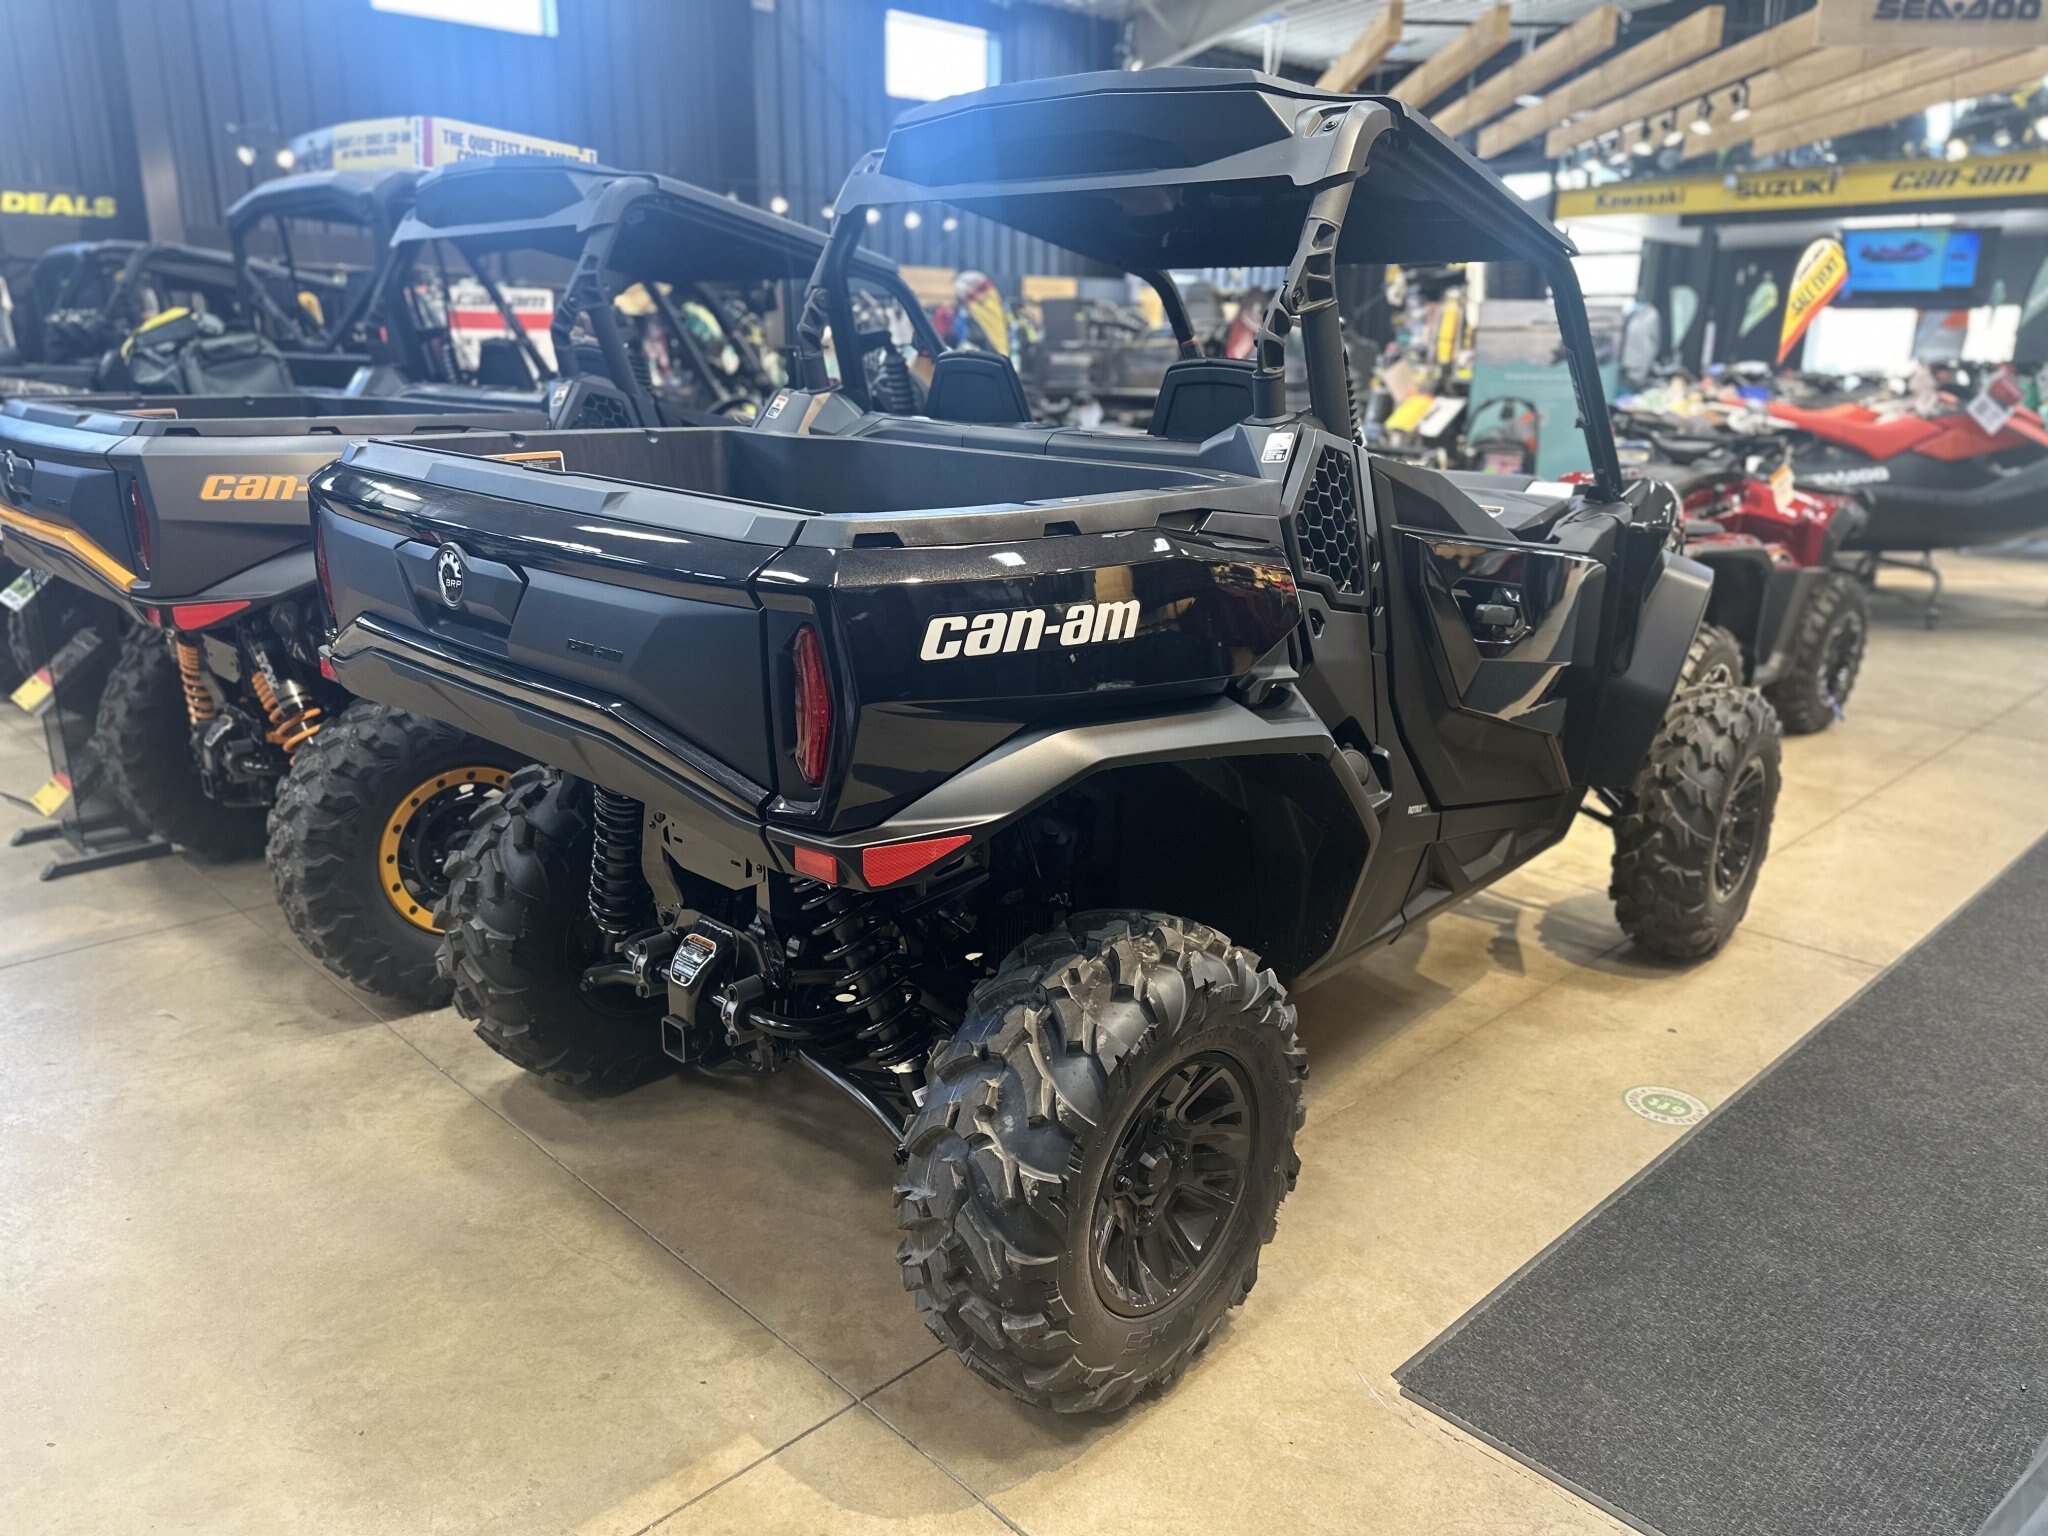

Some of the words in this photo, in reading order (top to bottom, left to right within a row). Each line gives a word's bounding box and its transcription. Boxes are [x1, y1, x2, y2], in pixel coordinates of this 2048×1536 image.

[443, 129, 464, 148] THE
[1595, 184, 1687, 209] Kawasaki
[1737, 176, 1836, 199] SUZUKI
[1891, 162, 2032, 191] can-am
[1, 190, 117, 218] DEALS
[445, 578, 462, 588] BRP
[920, 599, 1141, 661] can-am
